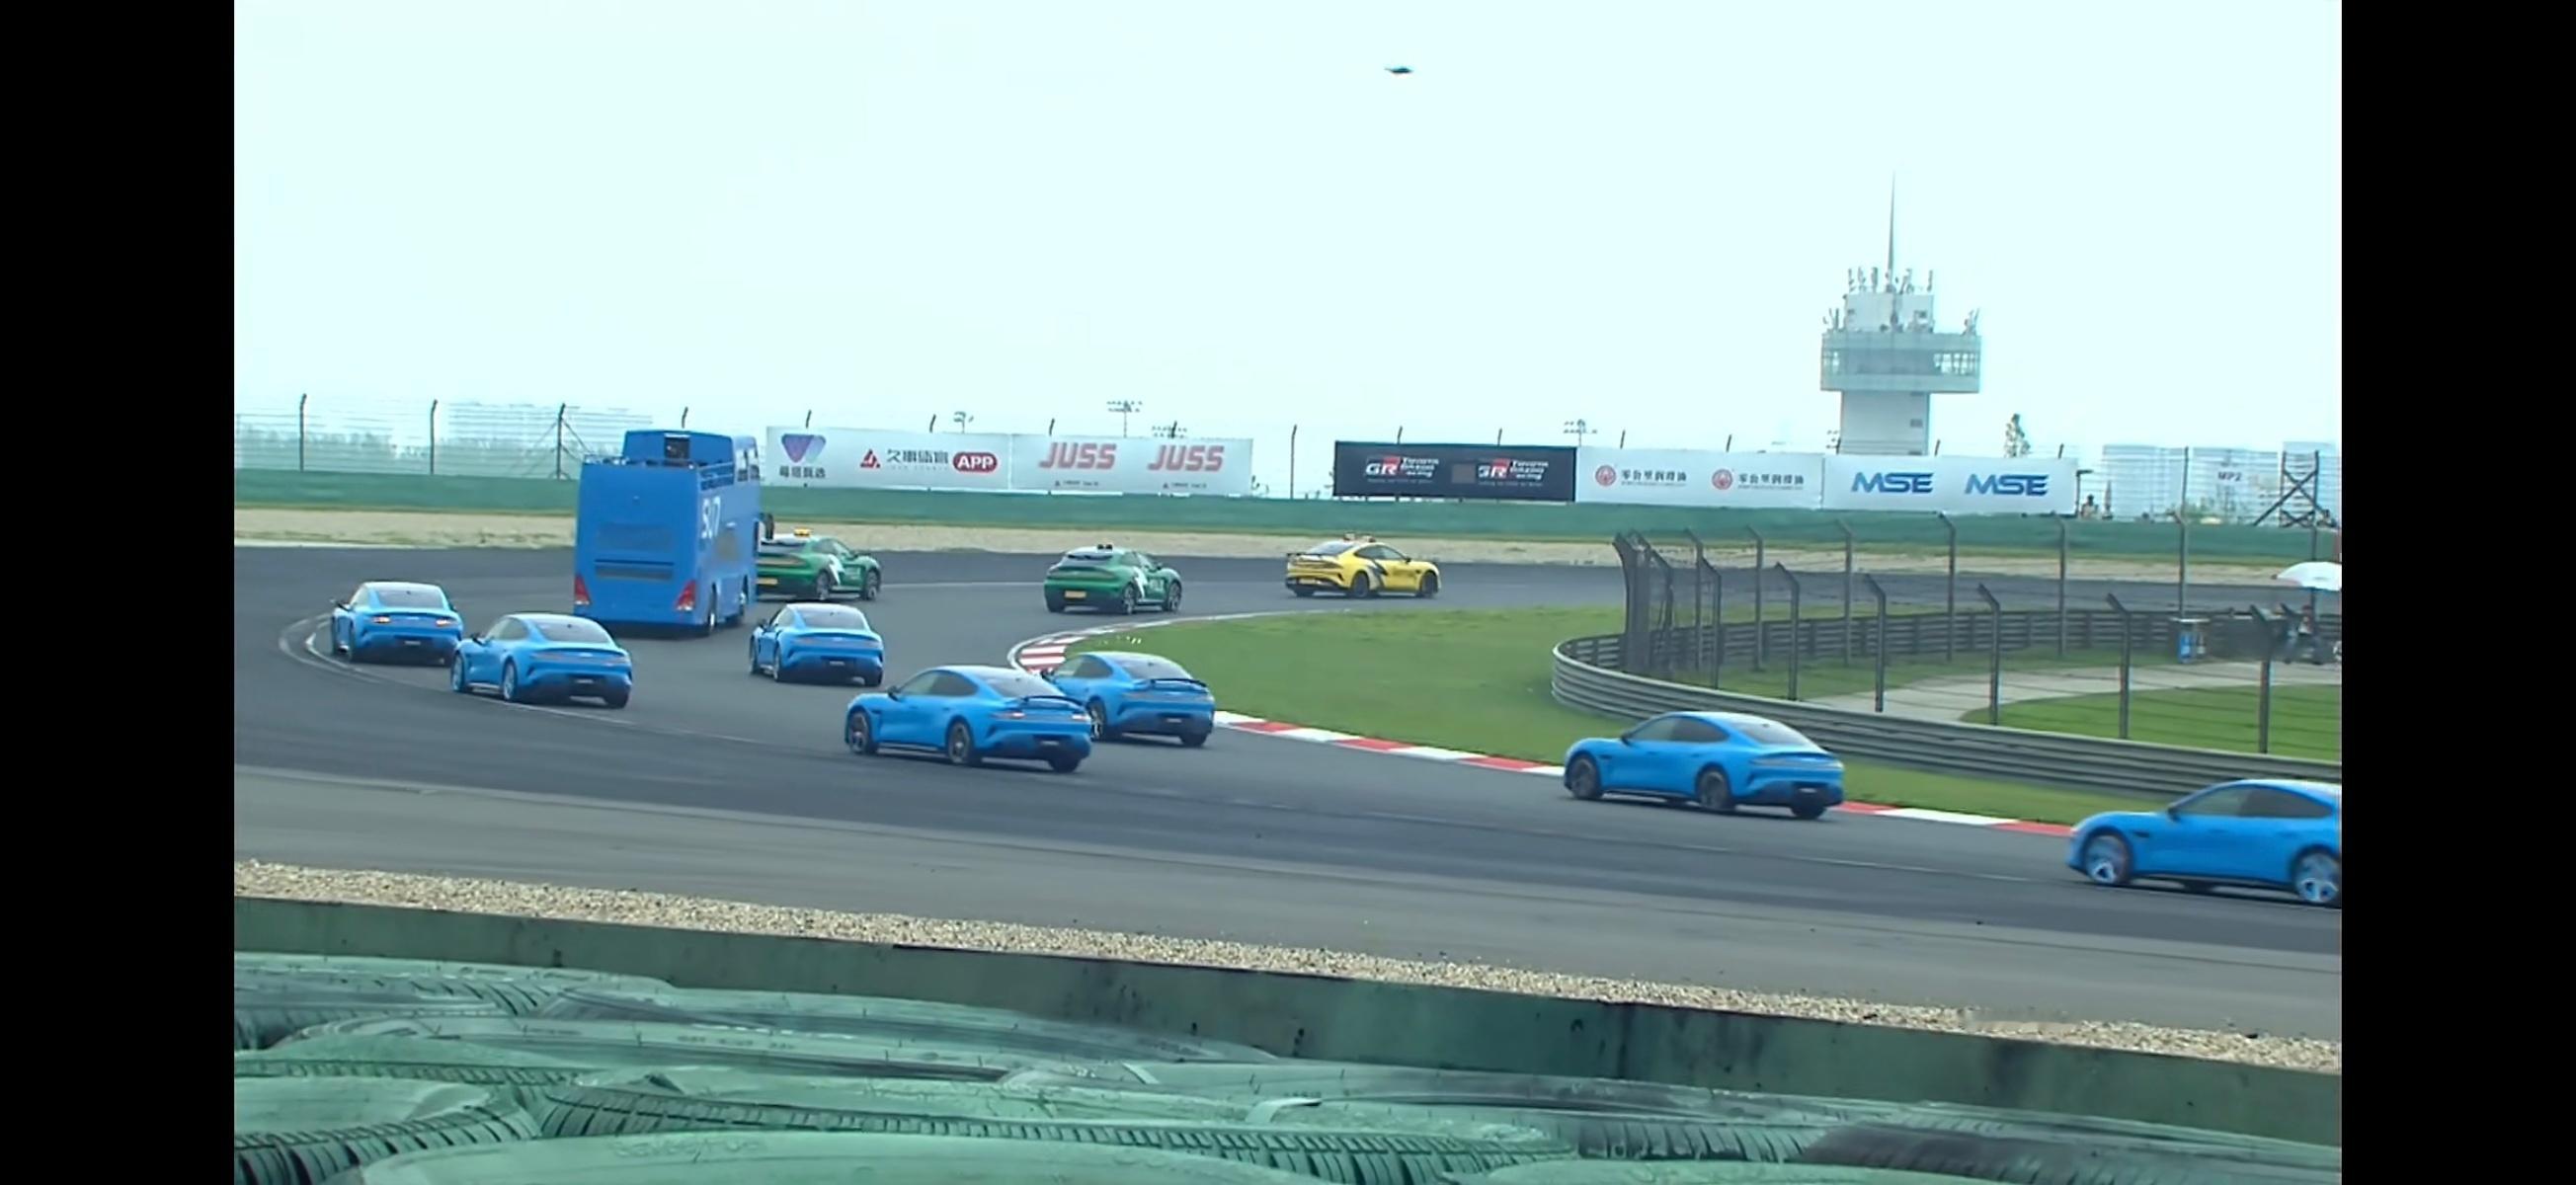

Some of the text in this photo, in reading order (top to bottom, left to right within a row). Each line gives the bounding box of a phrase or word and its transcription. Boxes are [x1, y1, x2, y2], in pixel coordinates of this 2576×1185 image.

[957, 454, 995, 469] APP
[1039, 442, 1117, 469] JUSS
[1147, 444, 1225, 472] JUSS
[1365, 463, 1398, 475] GR
[1851, 472, 1934, 493] MSE
[1966, 474, 2050, 496] MSE
